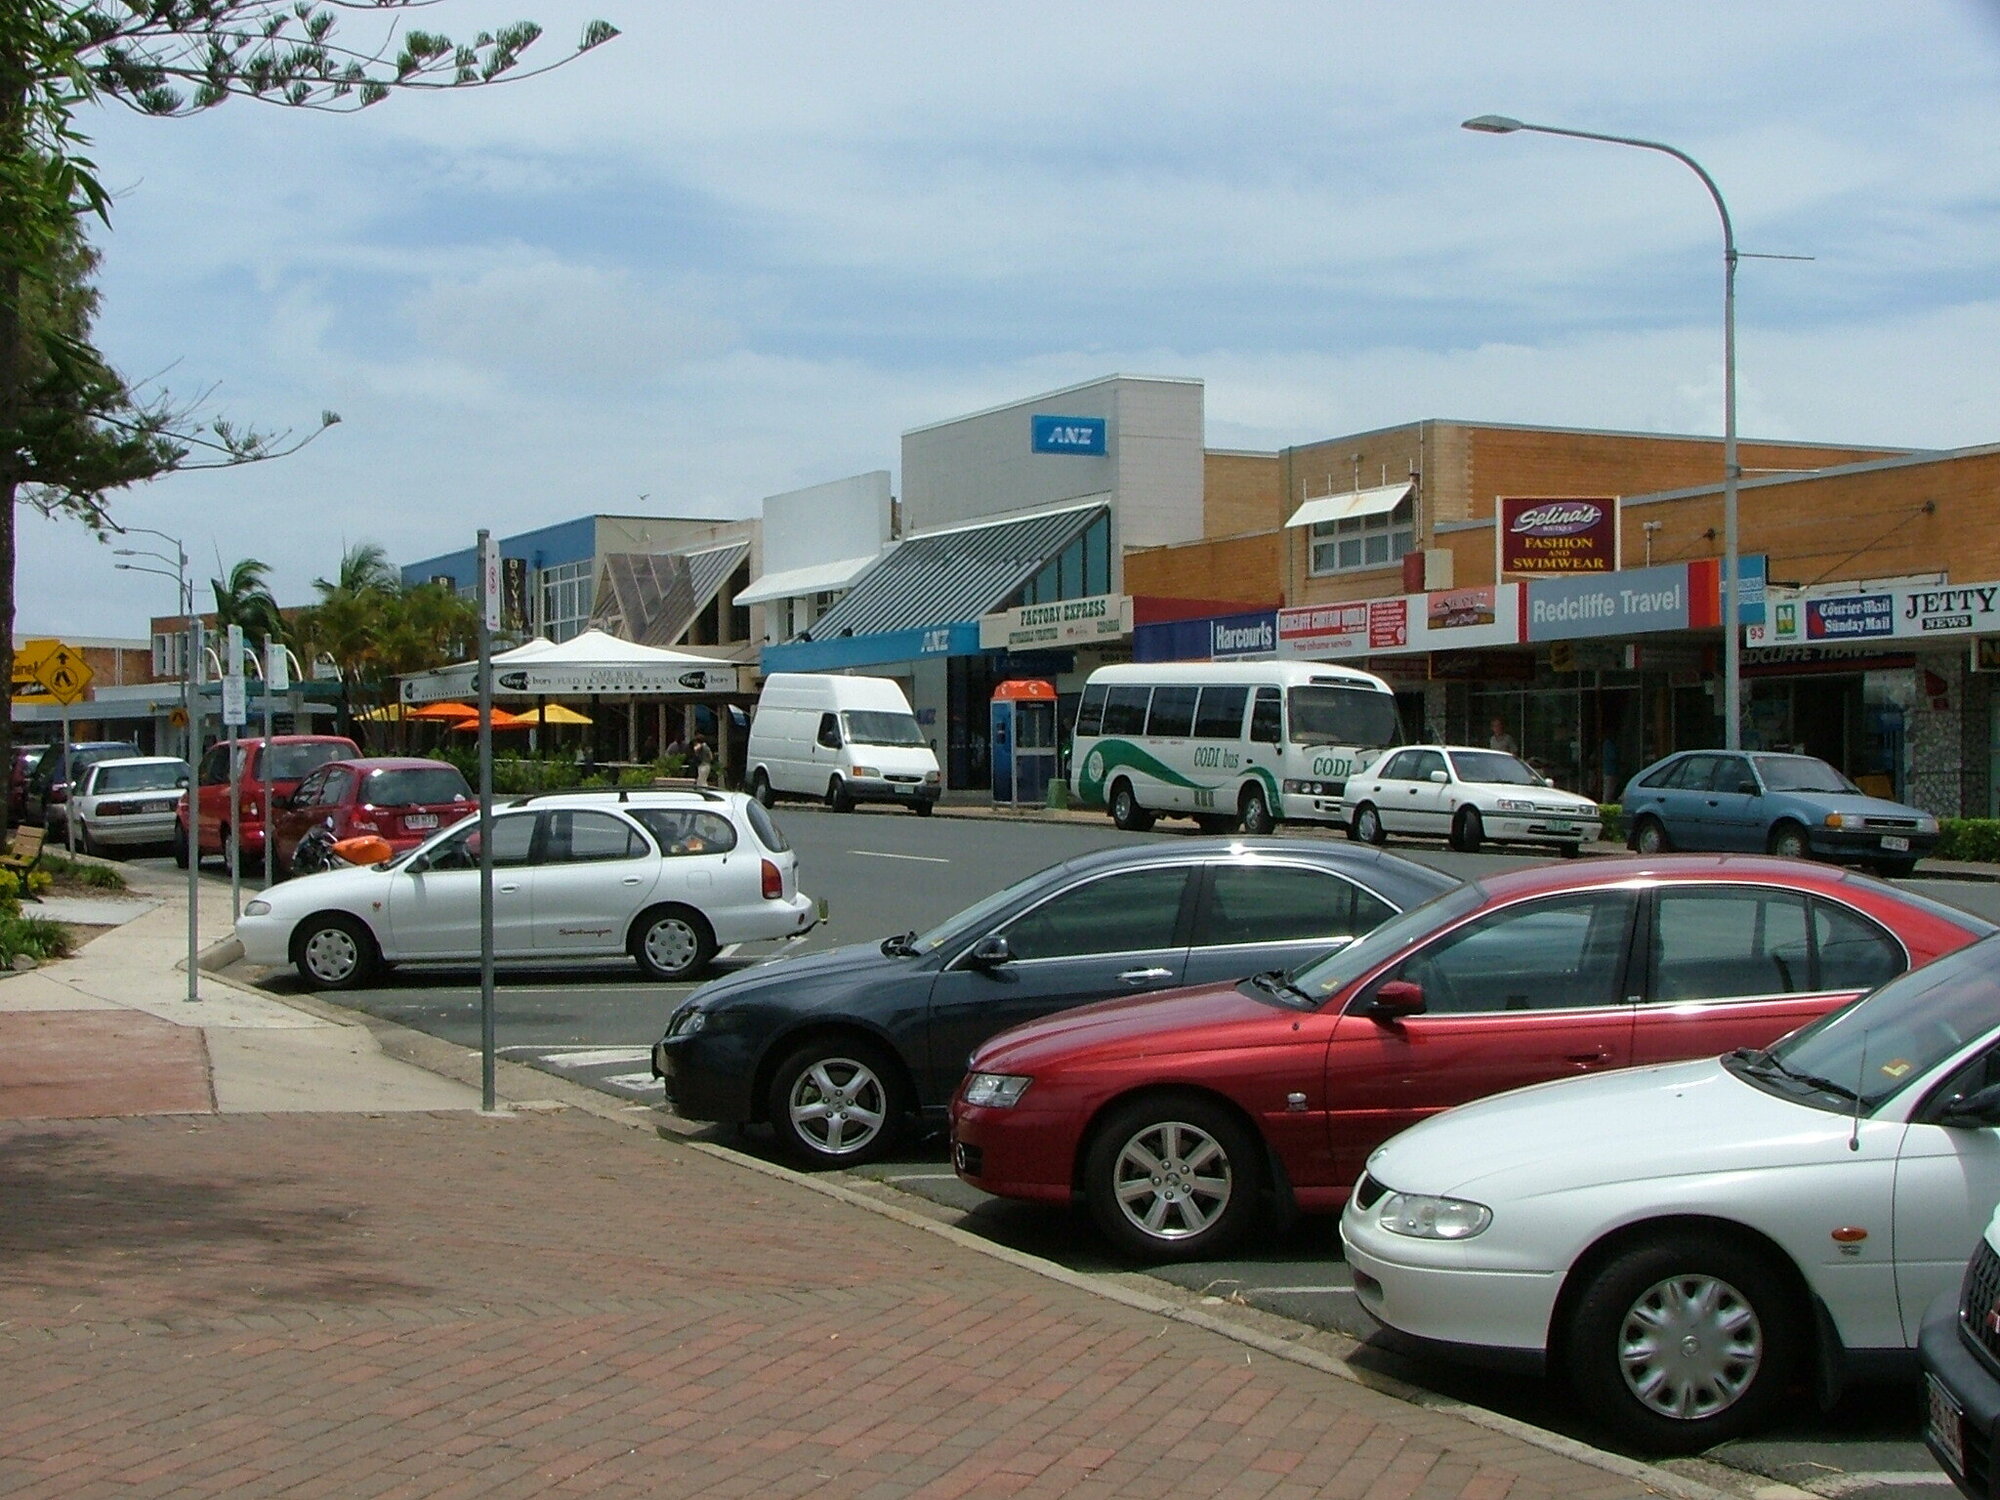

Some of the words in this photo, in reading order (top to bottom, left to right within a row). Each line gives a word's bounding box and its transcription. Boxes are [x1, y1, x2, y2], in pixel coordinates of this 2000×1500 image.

[1047, 426, 1093, 445] ANZ
[1510, 505, 1601, 533] Selina's
[1524, 538, 1593, 549] FASHION
[1512, 558, 1604, 569] SWIMWEAR
[1020, 605, 1062, 627] FACTORY
[1064, 599, 1106, 621] EXPRESS
[1532, 592, 1615, 623] Redcliffe
[1620, 584, 1681, 614] Travel
[1818, 600, 1891, 616] Courier-Mail
[1905, 587, 1998, 619] JETTY
[1824, 618, 1864, 633] Sunday
[1865, 616, 1891, 630] Mail
[1925, 616, 1969, 630] NEWS
[920, 629, 950, 653] ANZ
[1216, 621, 1273, 650] Harcourts
[1750, 627, 1765, 640] 93
[1741, 648, 1813, 664] EDCLIFFE
[1193, 746, 1220, 768] CODI
[1223, 748, 1240, 769] bus
[1312, 756, 1353, 777] CODI
